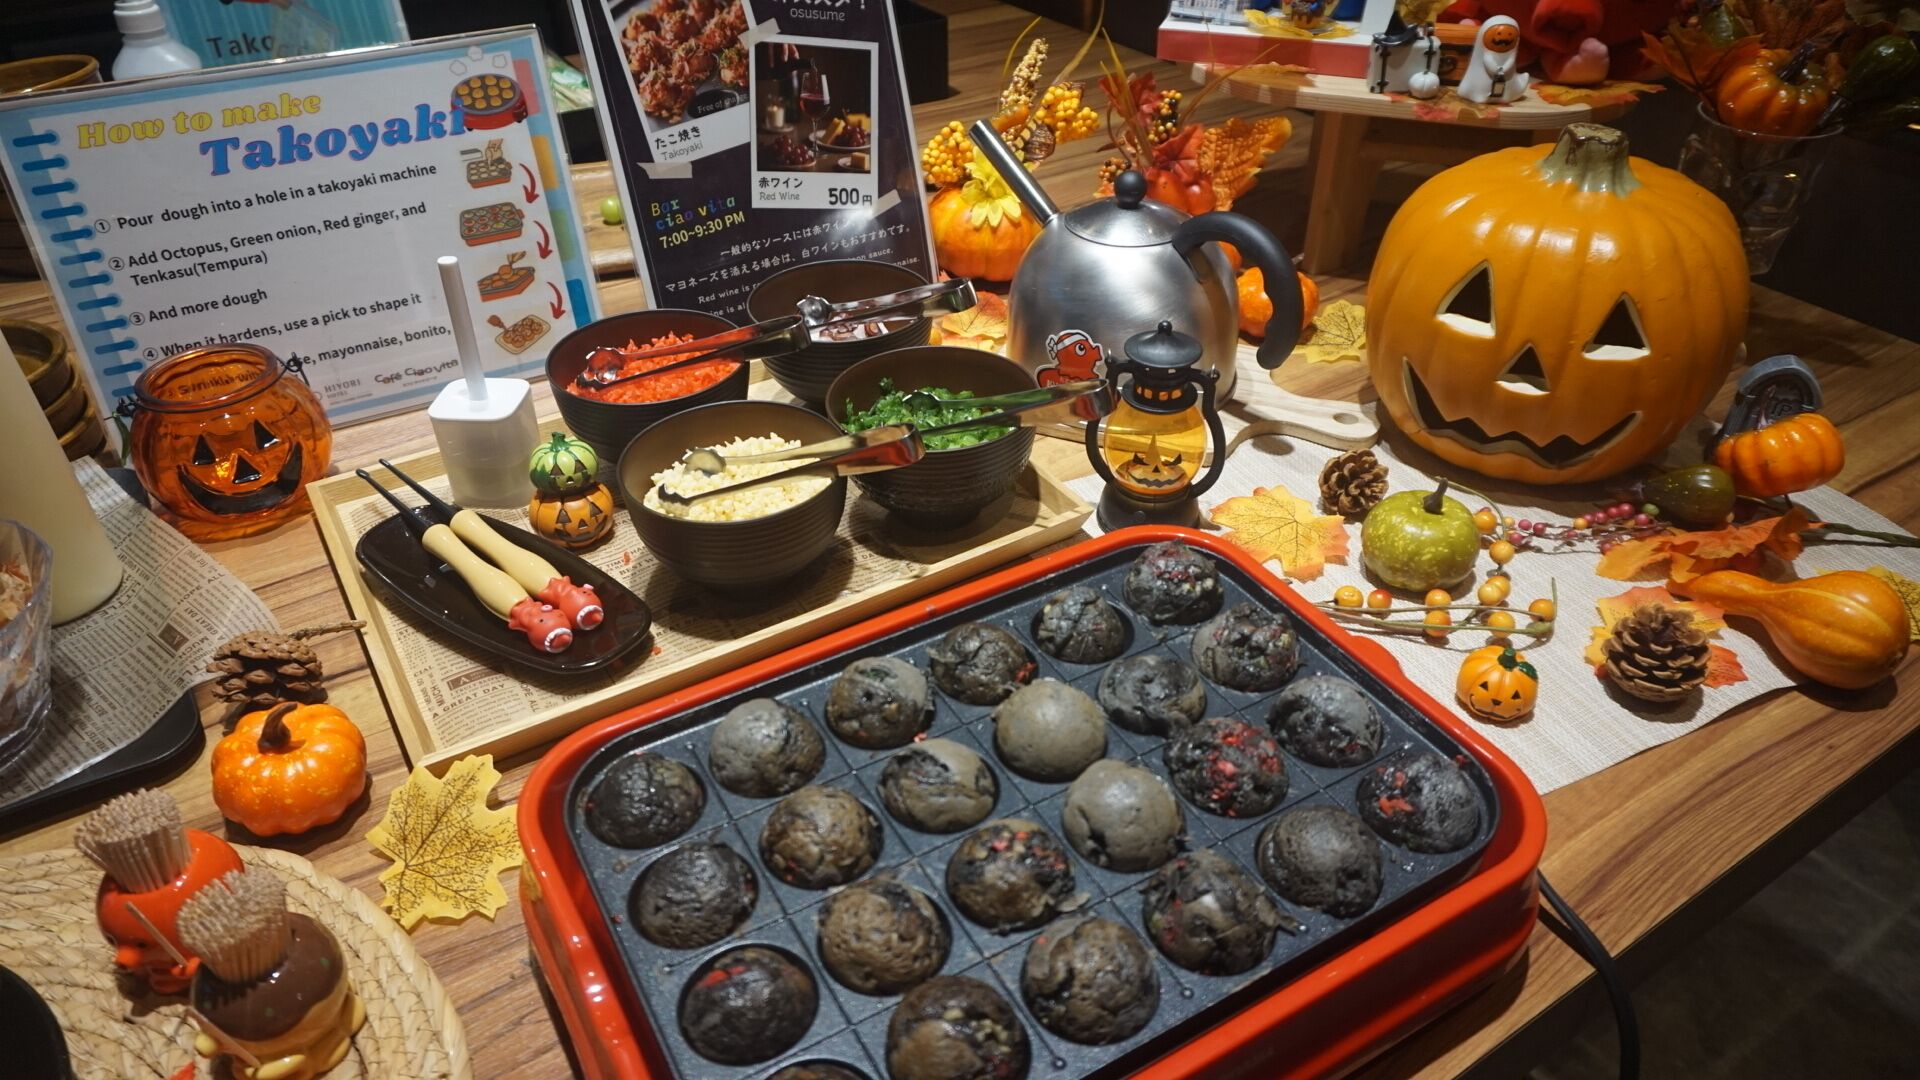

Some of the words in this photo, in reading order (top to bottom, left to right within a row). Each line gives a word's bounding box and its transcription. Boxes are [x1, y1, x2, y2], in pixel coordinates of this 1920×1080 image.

[790, 8, 845, 20] osusume
[77, 117, 164, 150] How
[173, 110, 212, 135] to
[222, 93, 321, 127] make
[199, 98, 468, 176] Takoyaki
[655, 126, 701, 149] たこ焼き
[661, 142, 703, 161] Takoyaki
[117, 213, 153, 229] Pour
[161, 204, 209, 220] dough
[211, 198, 241, 213] into
[245, 197, 253, 207] a
[255, 190, 288, 205] hole
[289, 187, 304, 199] in
[307, 186, 316, 196] a
[318, 173, 377, 194] takoyaki
[379, 164, 437, 184] machine
[759, 176, 803, 188] 赤ワイン
[759, 192, 776, 201] Red
[779, 191, 800, 201] Wine
[651, 199, 680, 217] Bar
[656, 210, 694, 230] ciao
[698, 197, 736, 217] vita
[128, 251, 158, 267] Add
[161, 240, 228, 261] Octopus,
[230, 231, 273, 248] Green
[276, 223, 321, 240] onion,
[323, 216, 350, 231] Red
[352, 208, 399, 229] ginger,
[401, 201, 427, 217] and
[659, 219, 723, 249] 7:00~9:30
[724, 211, 745, 228] PM
[130, 250, 268, 286] Tenkasu(Tempura)
[149, 306, 178, 322] And
[181, 299, 219, 315] more
[222, 289, 268, 306] dough
[698, 294, 716, 304] Red
[718, 288, 739, 298] wine
[160, 339, 202, 357] When
[205, 336, 216, 346] it
[218, 325, 282, 345] hardens,
[284, 319, 308, 331] use
[311, 316, 319, 326] a
[322, 308, 351, 325] pick
[353, 305, 367, 317] to
[370, 297, 409, 313] shape
[410, 293, 422, 304] it
[318, 335, 403, 361] mayonnaise,
[404, 324, 451, 342] bonito,
[324, 378, 361, 393] HIYORI
[443, 692, 479, 712] GREAT
[483, 683, 506, 694] DAY
